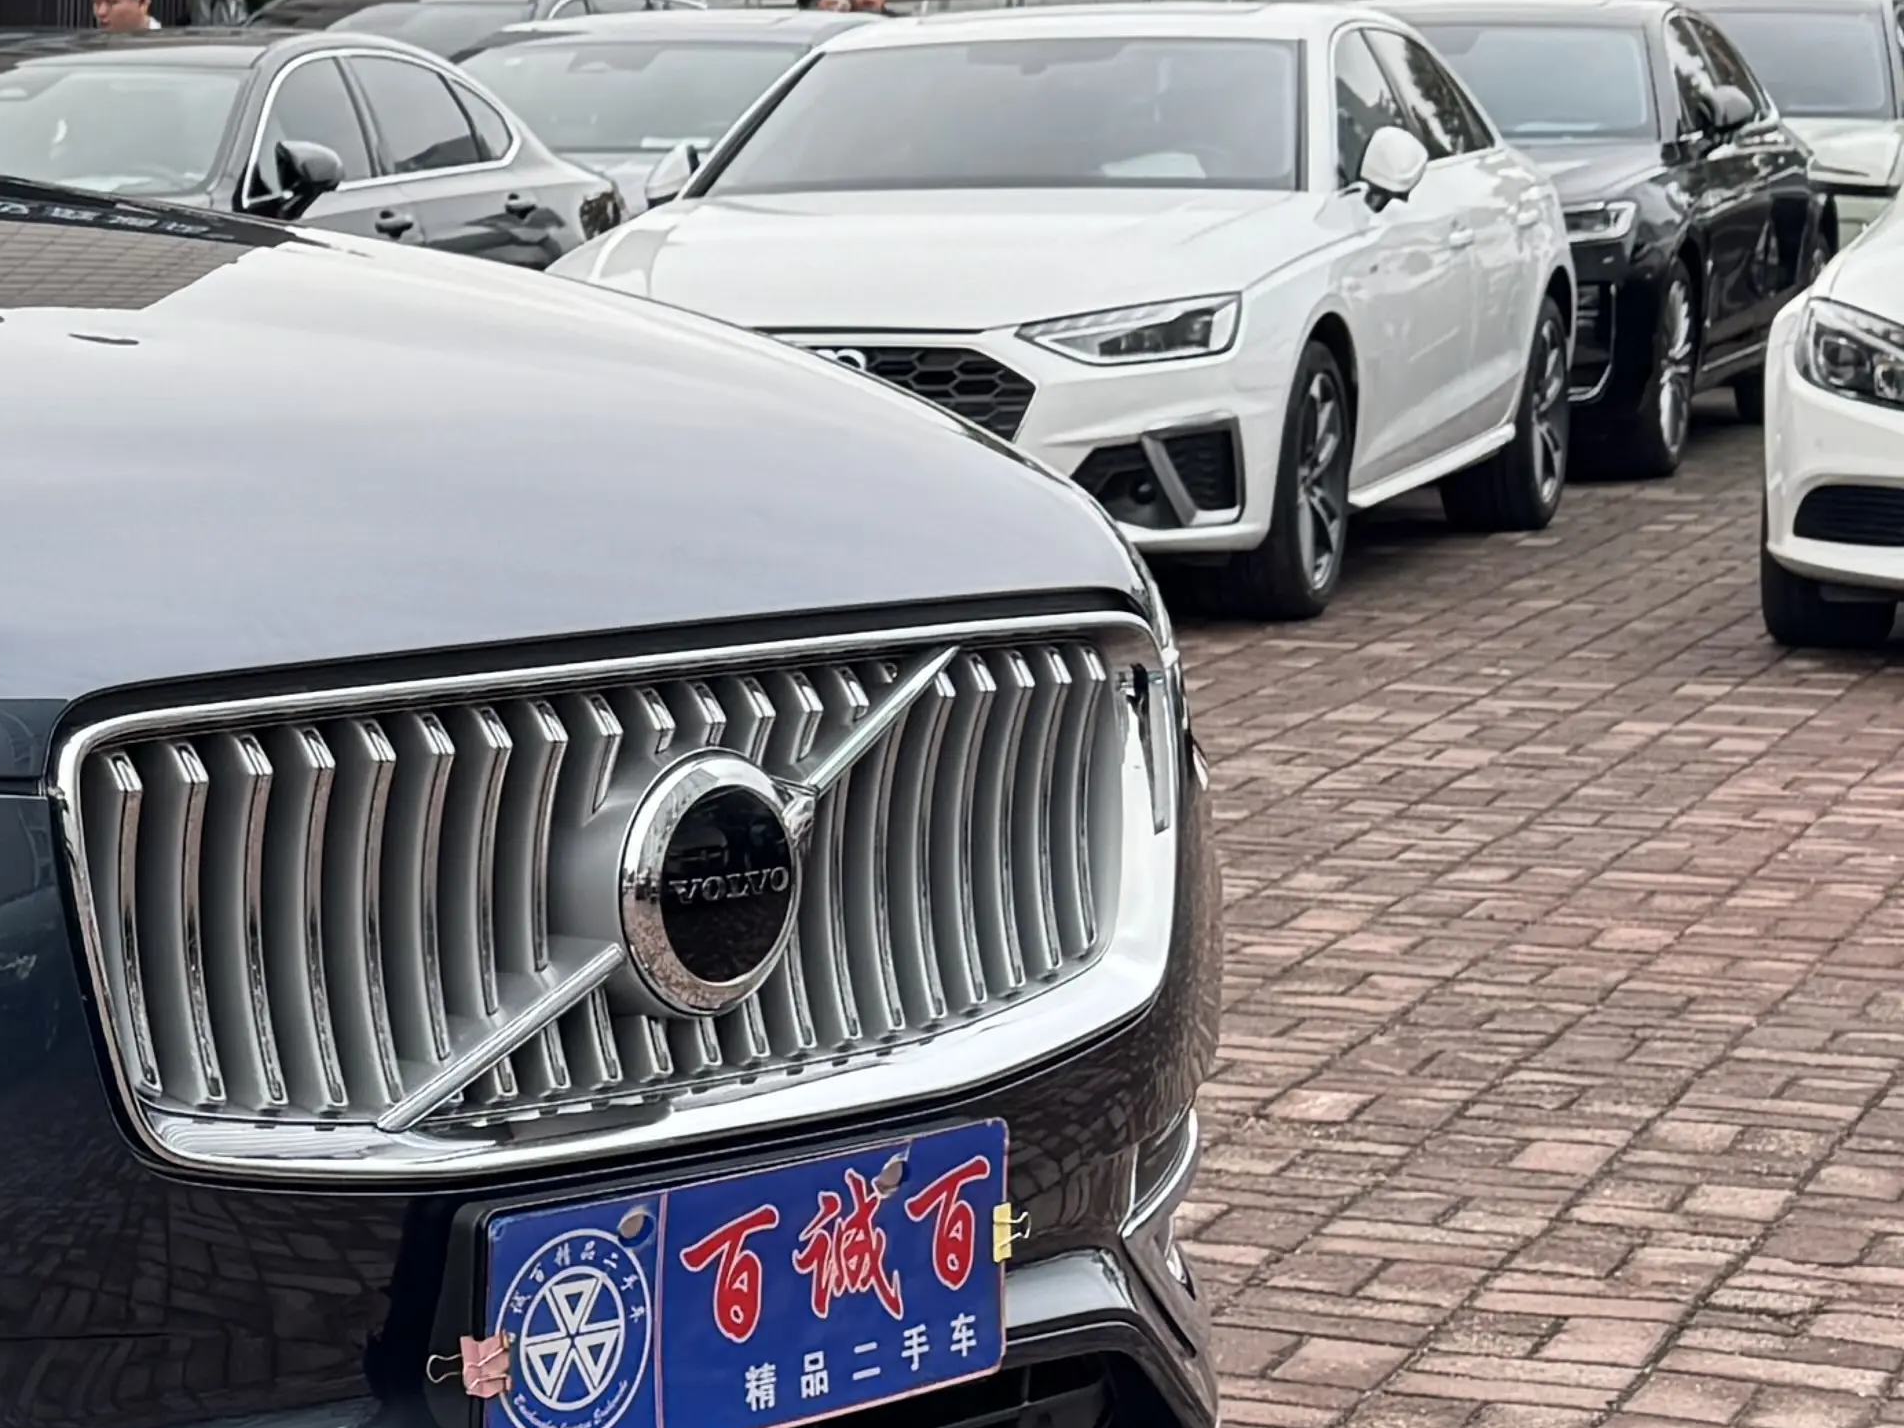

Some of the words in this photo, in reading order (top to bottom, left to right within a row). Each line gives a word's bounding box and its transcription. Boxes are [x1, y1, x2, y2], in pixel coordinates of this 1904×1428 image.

[668, 866, 789, 904] VOLVO
[507, 1239, 645, 1344] 诚百精品二手车
[680, 1156, 990, 1342] 百诚百
[744, 1313, 977, 1412] 精品二手车
